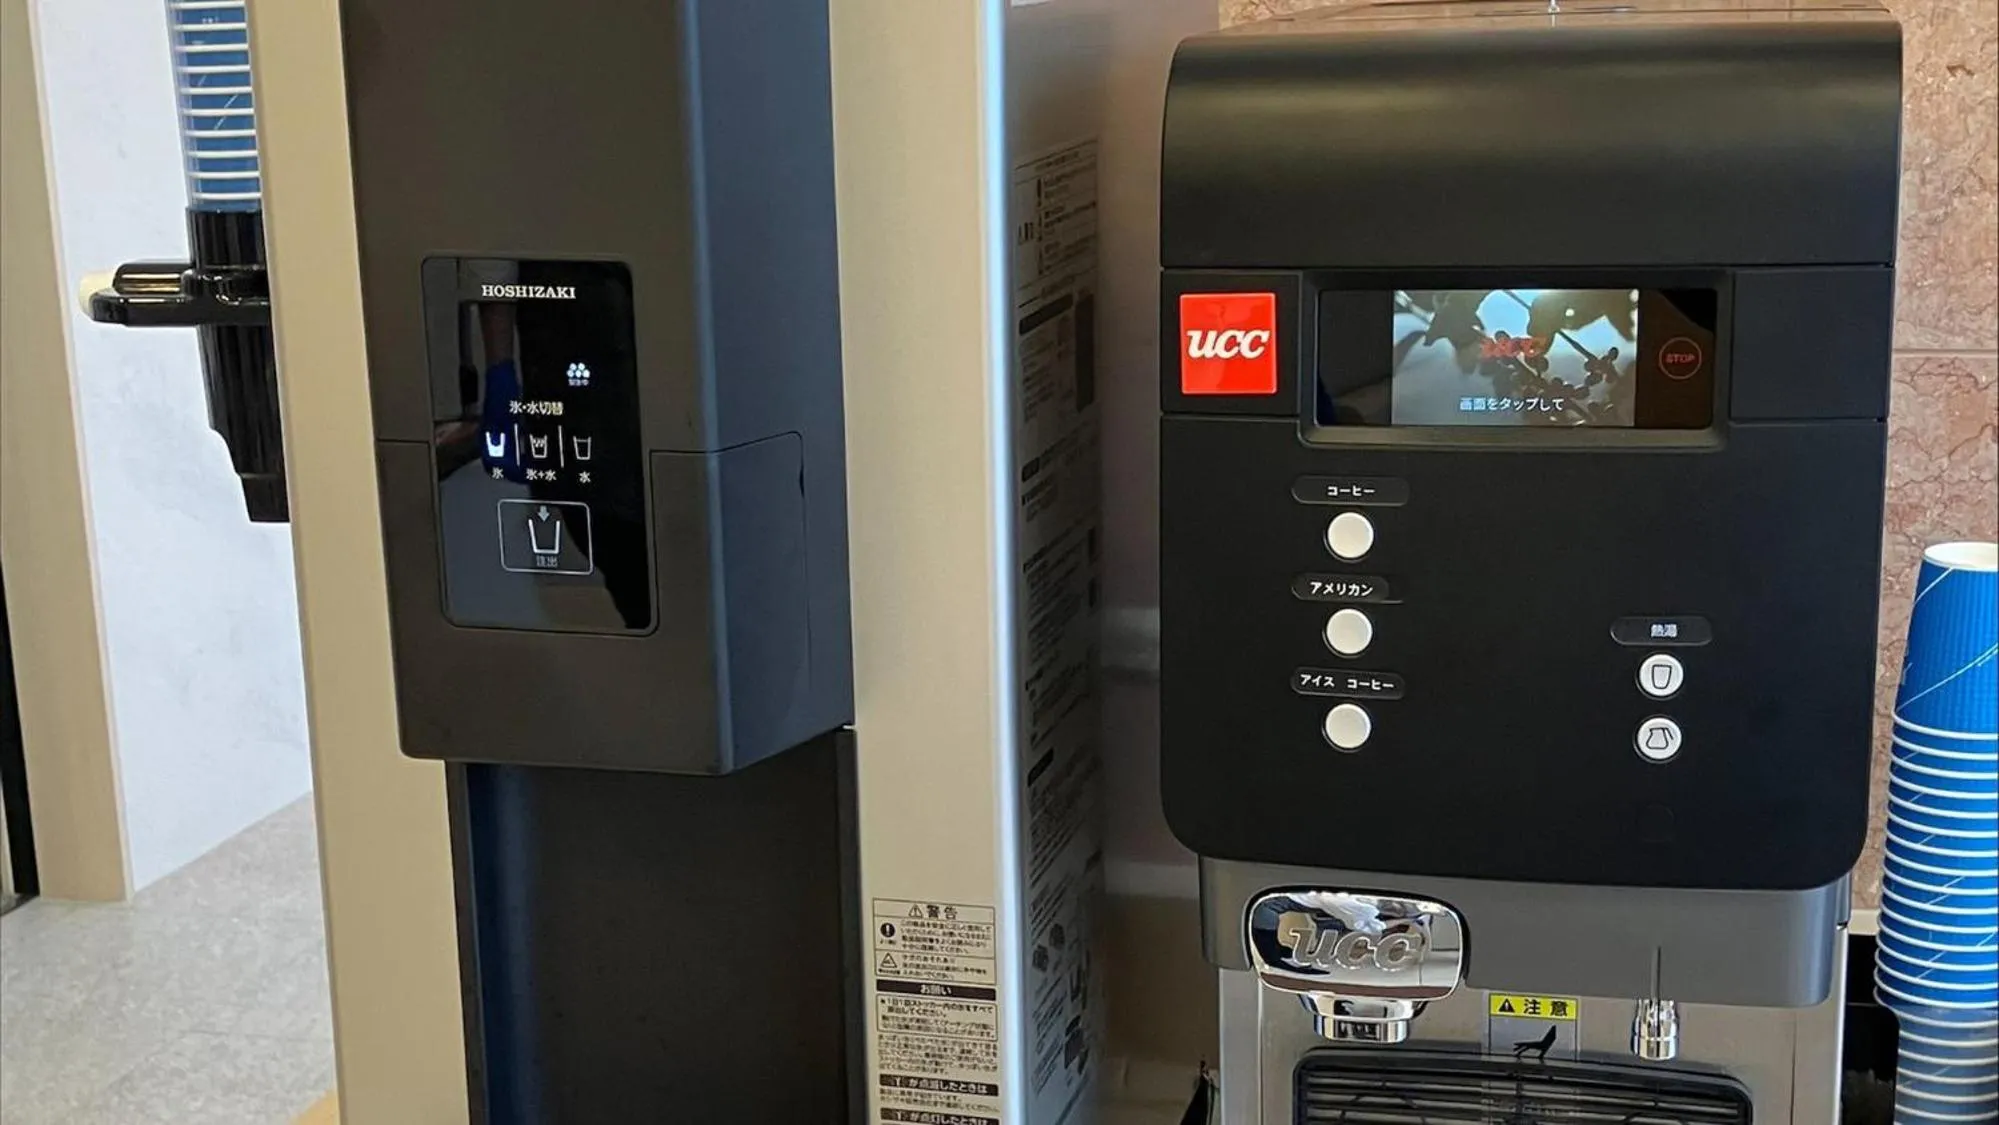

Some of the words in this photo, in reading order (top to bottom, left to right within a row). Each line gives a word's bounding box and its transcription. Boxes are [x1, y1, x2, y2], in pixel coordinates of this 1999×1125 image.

[481, 284, 576, 299] HOSHIZAKI
[1665, 352, 1696, 364] STOP
[509, 400, 564, 415] 氷・水切替
[1459, 397, 1564, 412] 画面をタップして
[492, 466, 504, 480] 氷
[579, 470, 592, 484] 水
[1327, 484, 1376, 497] コーヒー
[1310, 581, 1374, 597] アメリカン
[1523, 998, 1567, 1017] 注意
